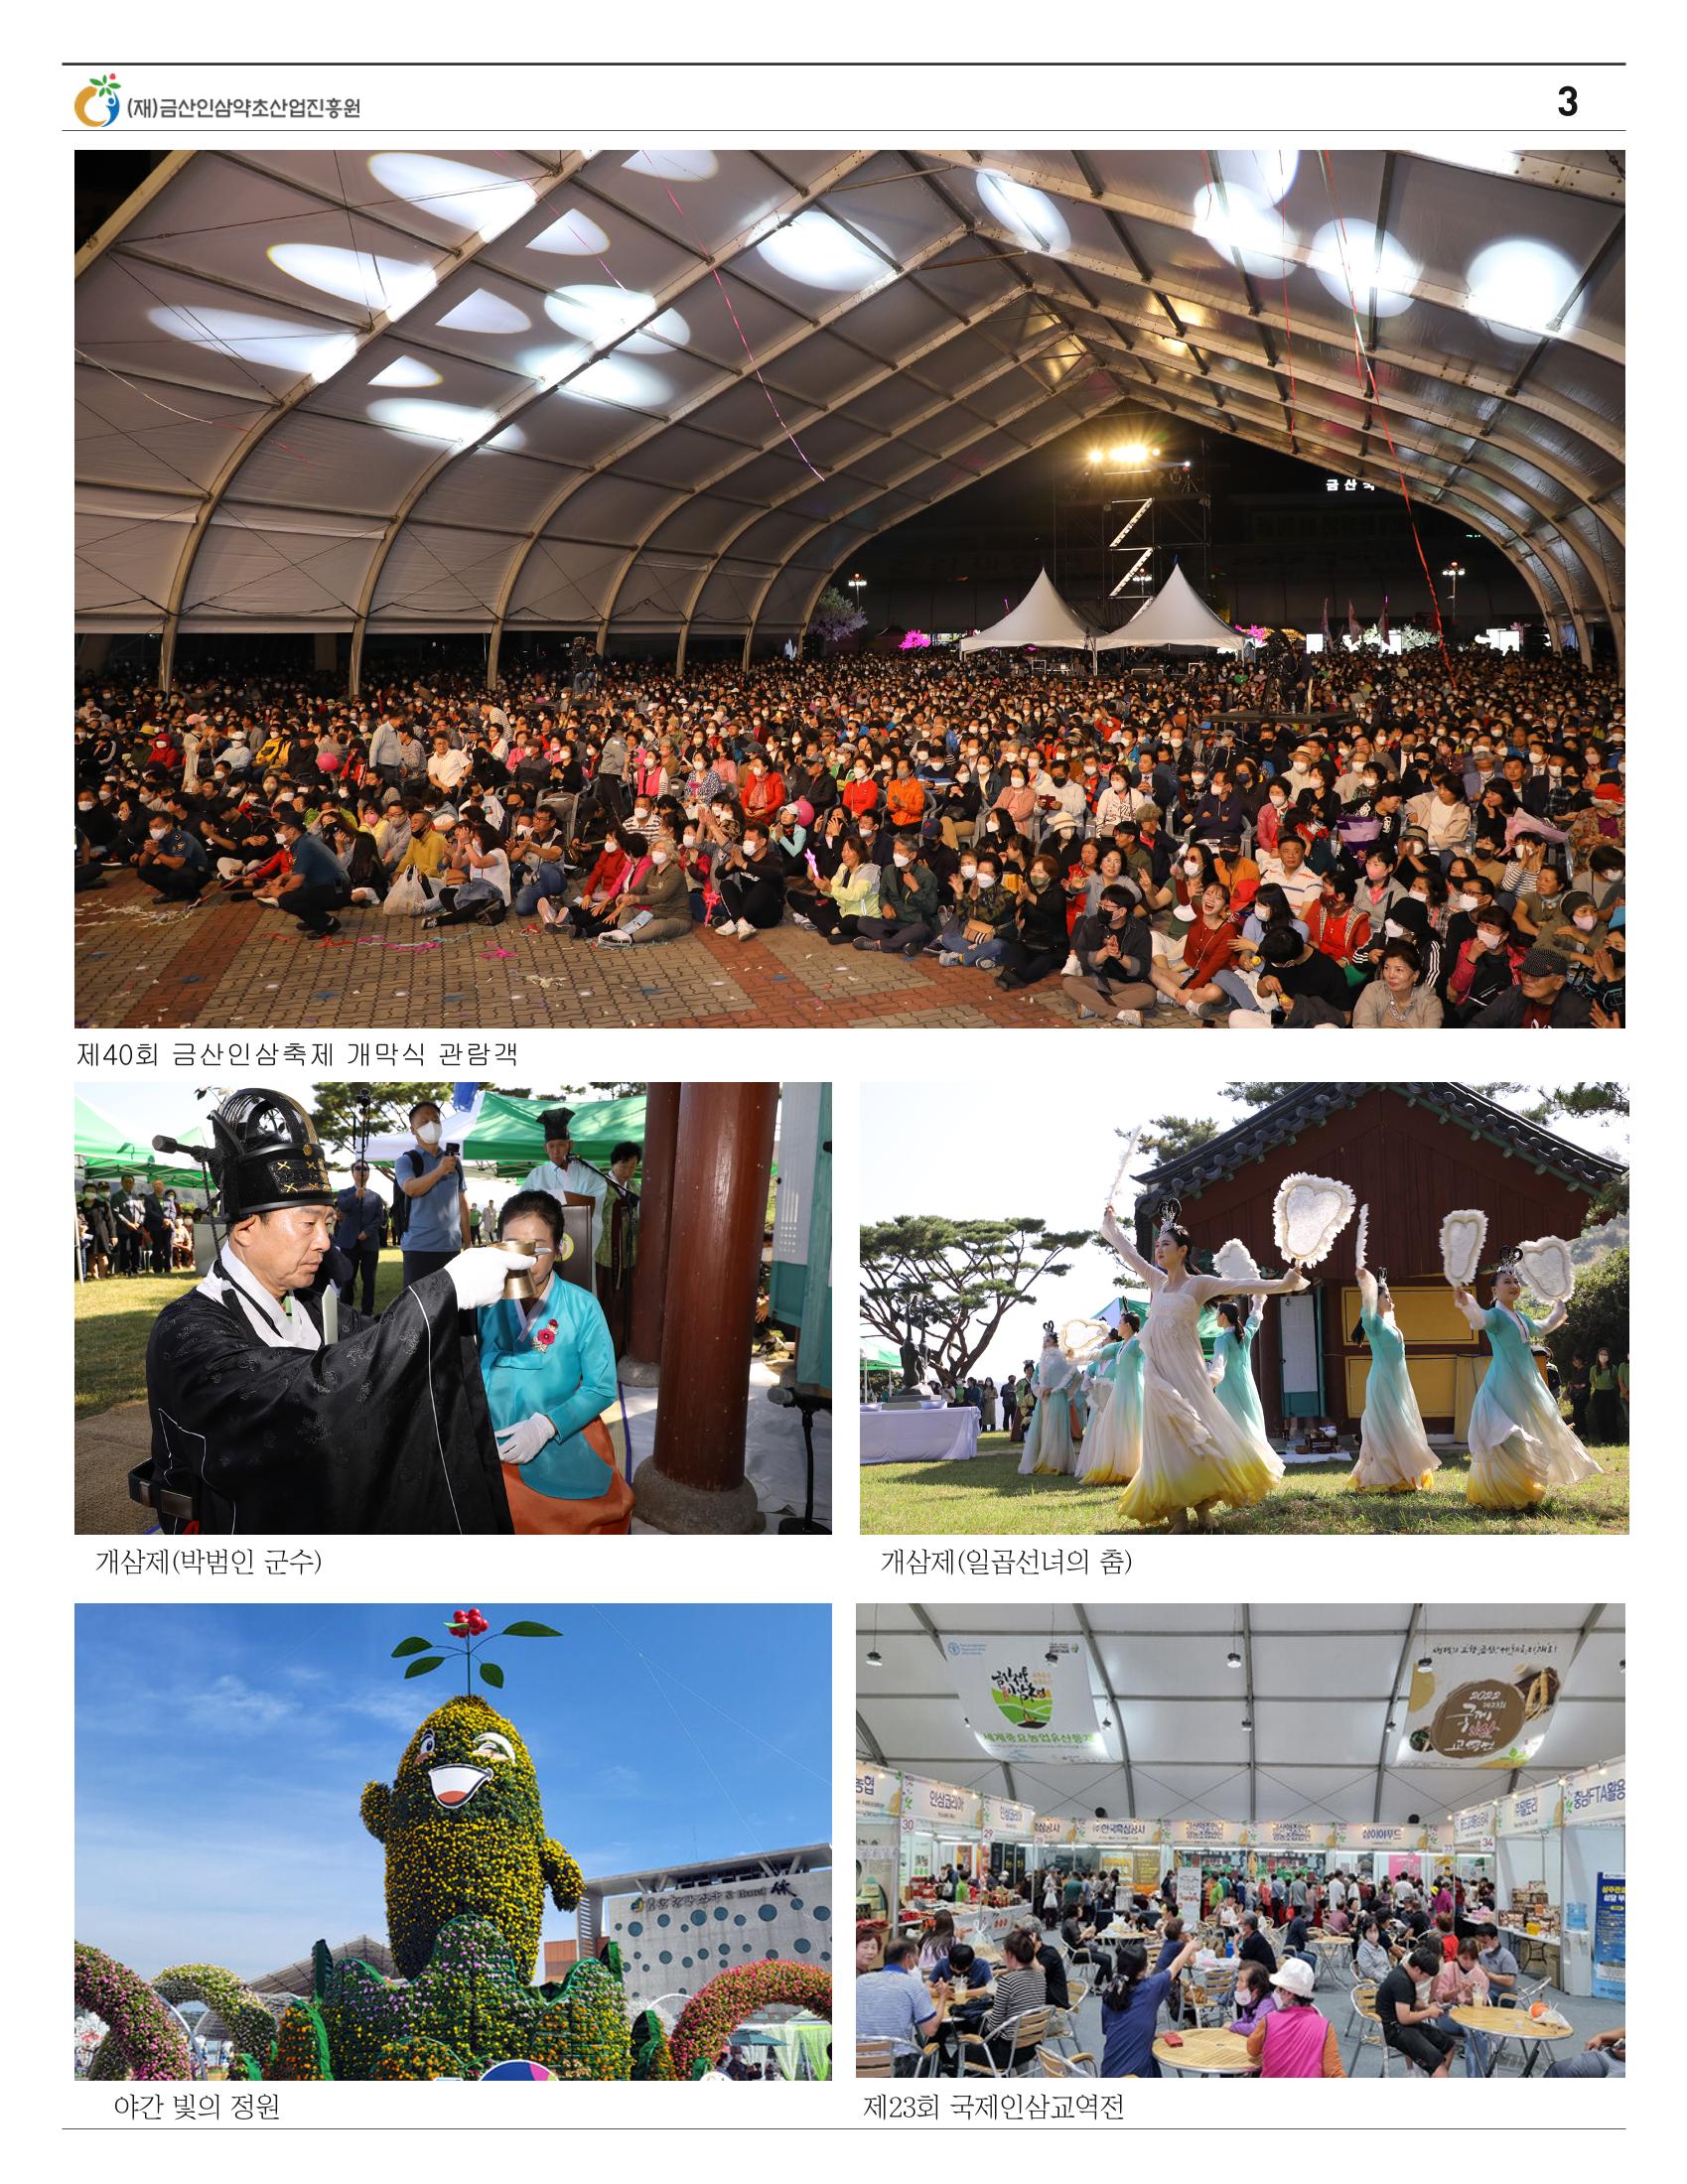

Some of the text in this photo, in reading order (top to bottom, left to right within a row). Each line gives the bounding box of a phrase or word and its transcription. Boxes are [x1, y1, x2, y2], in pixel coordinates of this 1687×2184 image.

[128, 98, 360, 119] (재)금산인삼약초산업진흥원
[1558, 85, 1579, 117] 3
[1470, 1691, 1501, 1701] 2022
[902, 1819, 914, 1832] 30
[771, 1878, 797, 1897] 休
